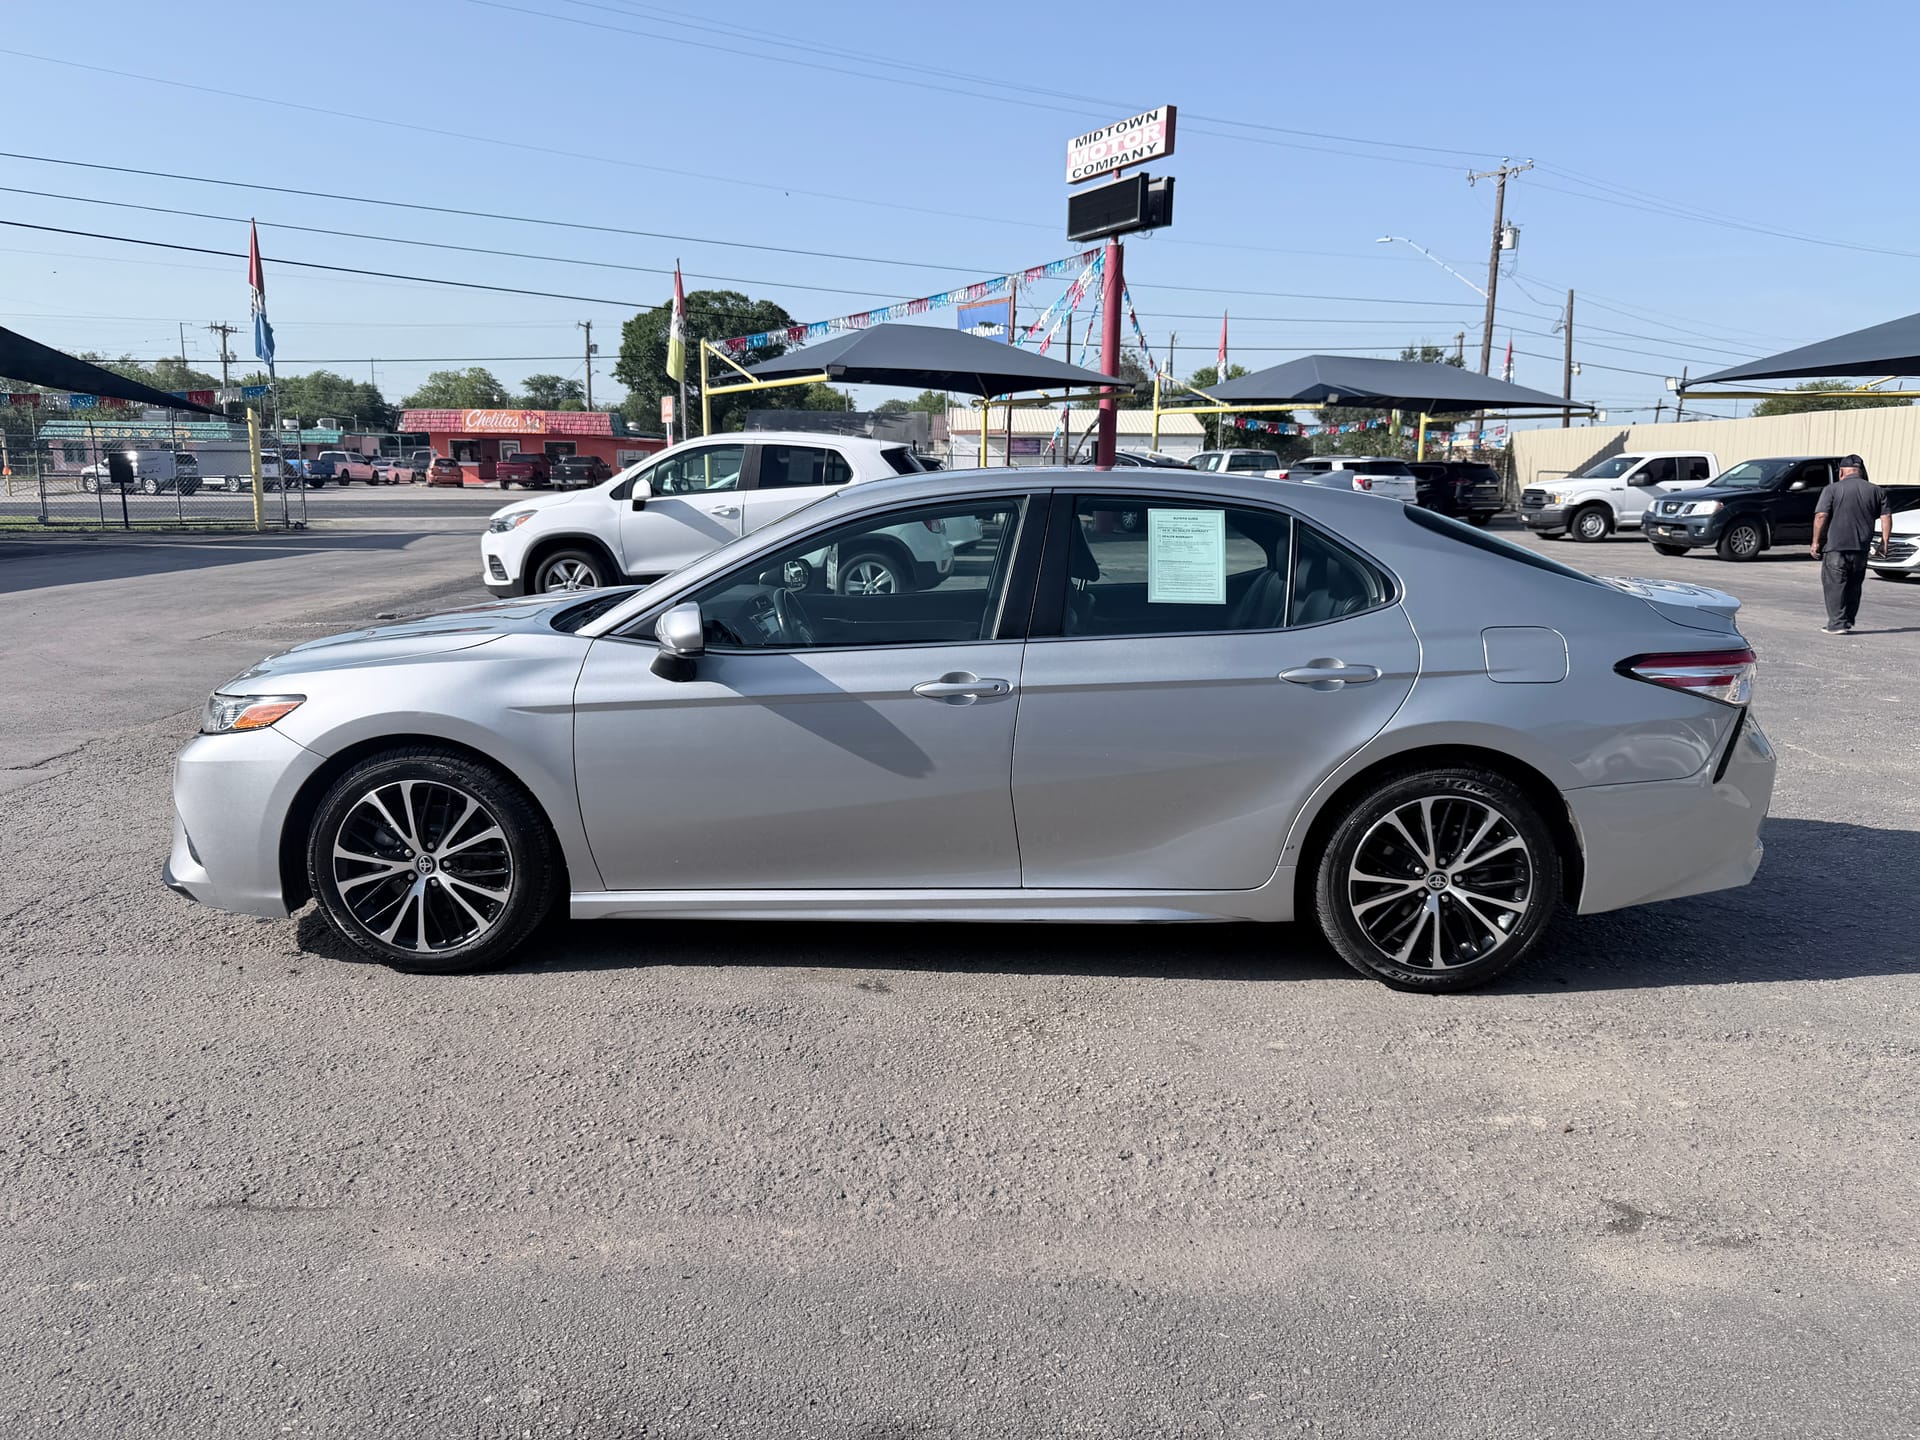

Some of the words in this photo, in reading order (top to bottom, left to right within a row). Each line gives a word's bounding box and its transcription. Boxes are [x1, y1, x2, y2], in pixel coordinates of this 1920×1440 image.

[1068, 124, 1162, 168] MOTOR
[1075, 110, 1159, 148] MIDTOWN
[1072, 142, 1158, 179] COMPANY
[466, 409, 519, 427] Chelitas
